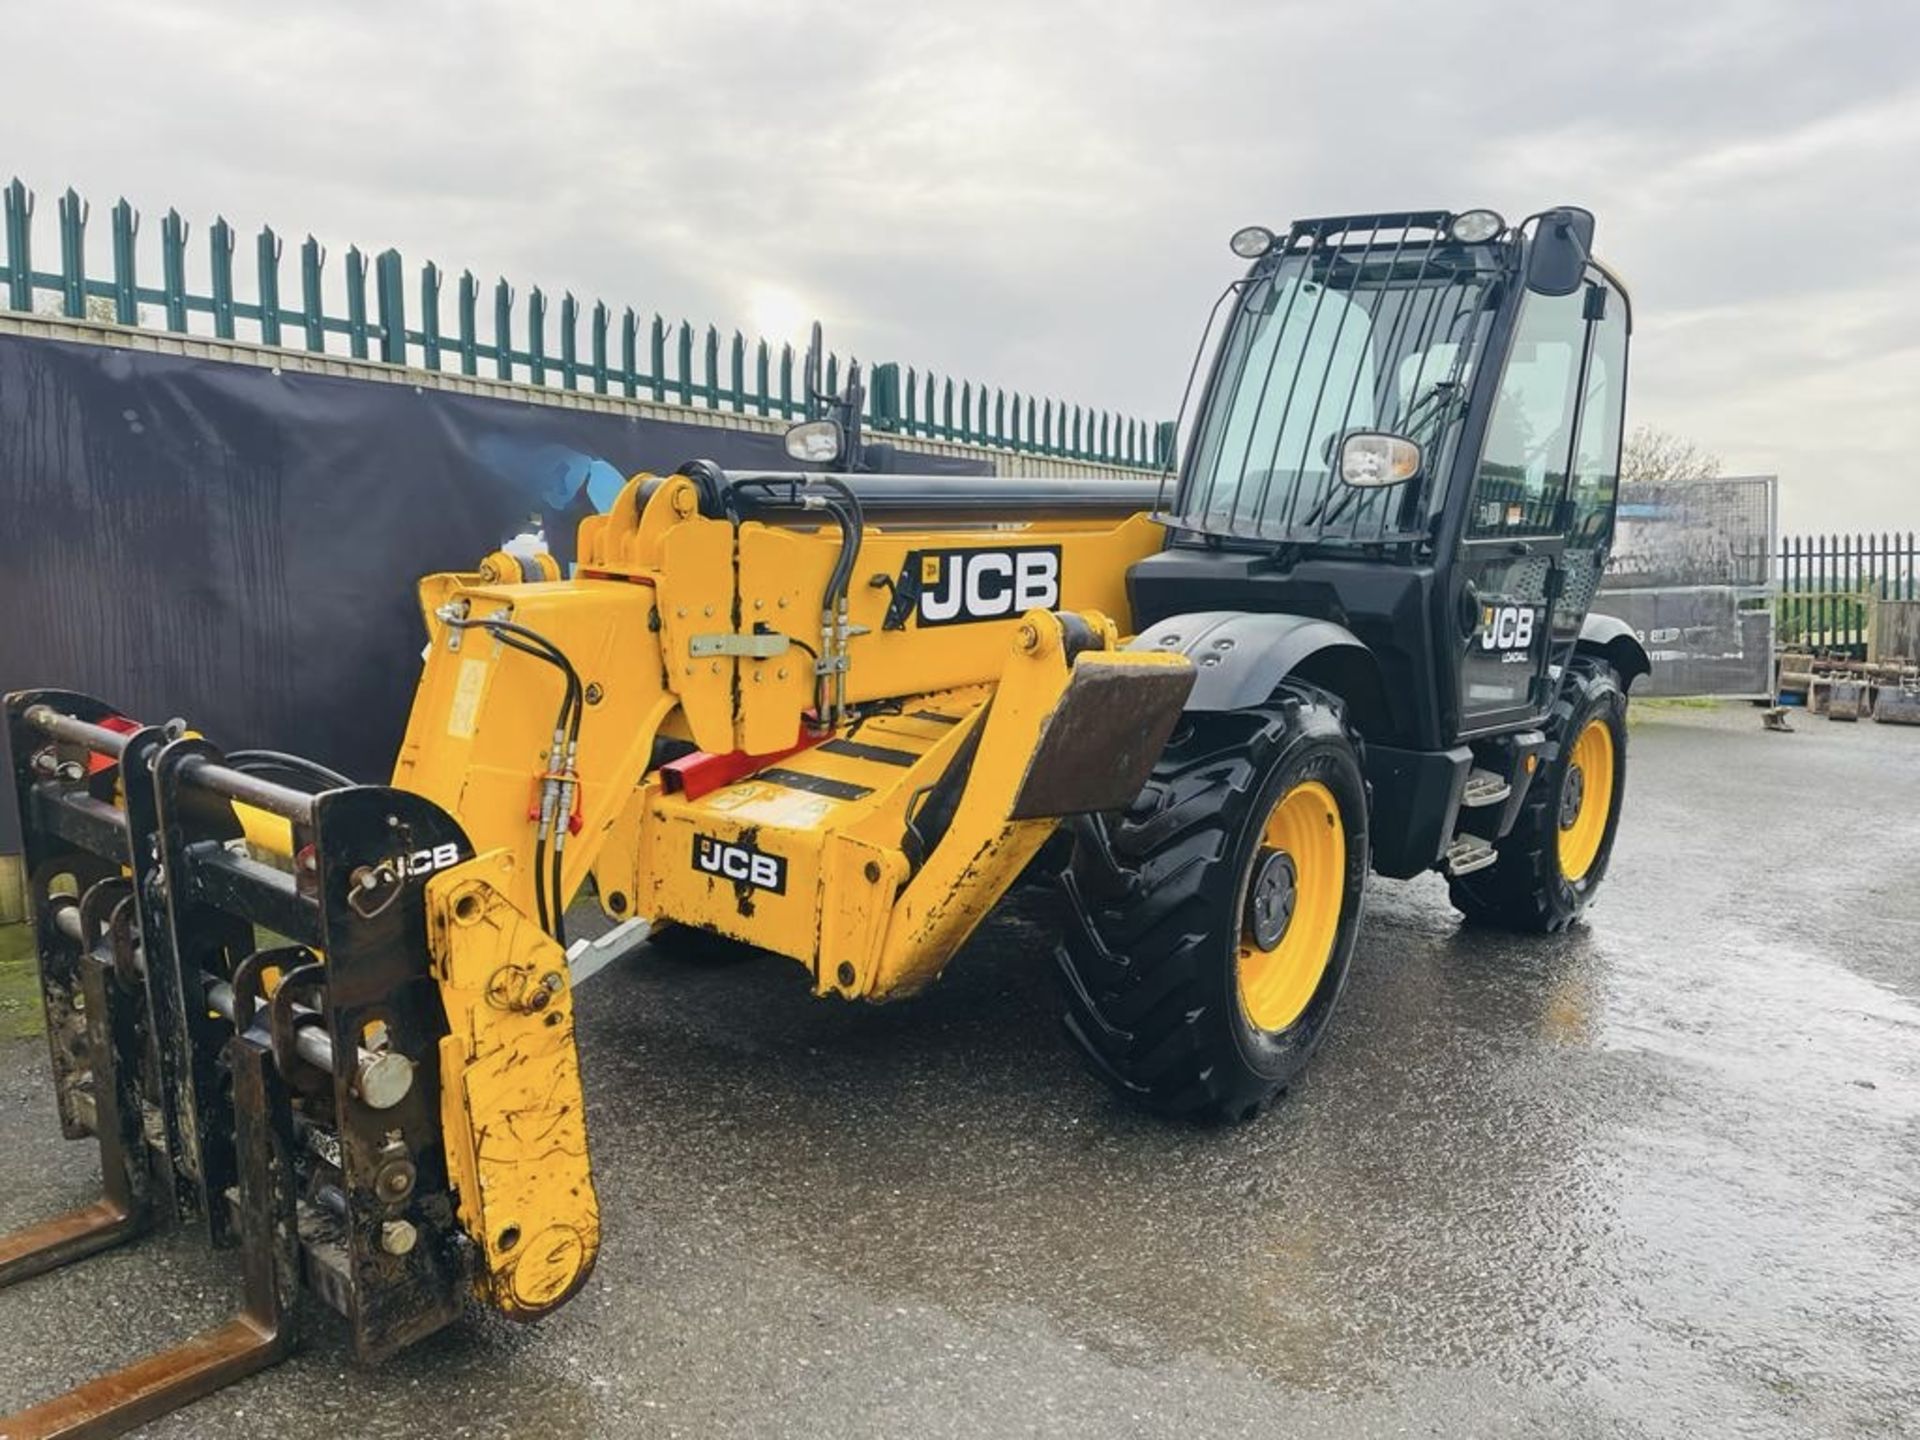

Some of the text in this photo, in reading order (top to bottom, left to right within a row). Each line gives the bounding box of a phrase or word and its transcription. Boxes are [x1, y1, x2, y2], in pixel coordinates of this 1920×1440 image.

[921, 551, 1058, 620] JCB
[1482, 607, 1534, 649] JCB
[700, 843, 778, 888] JCB
